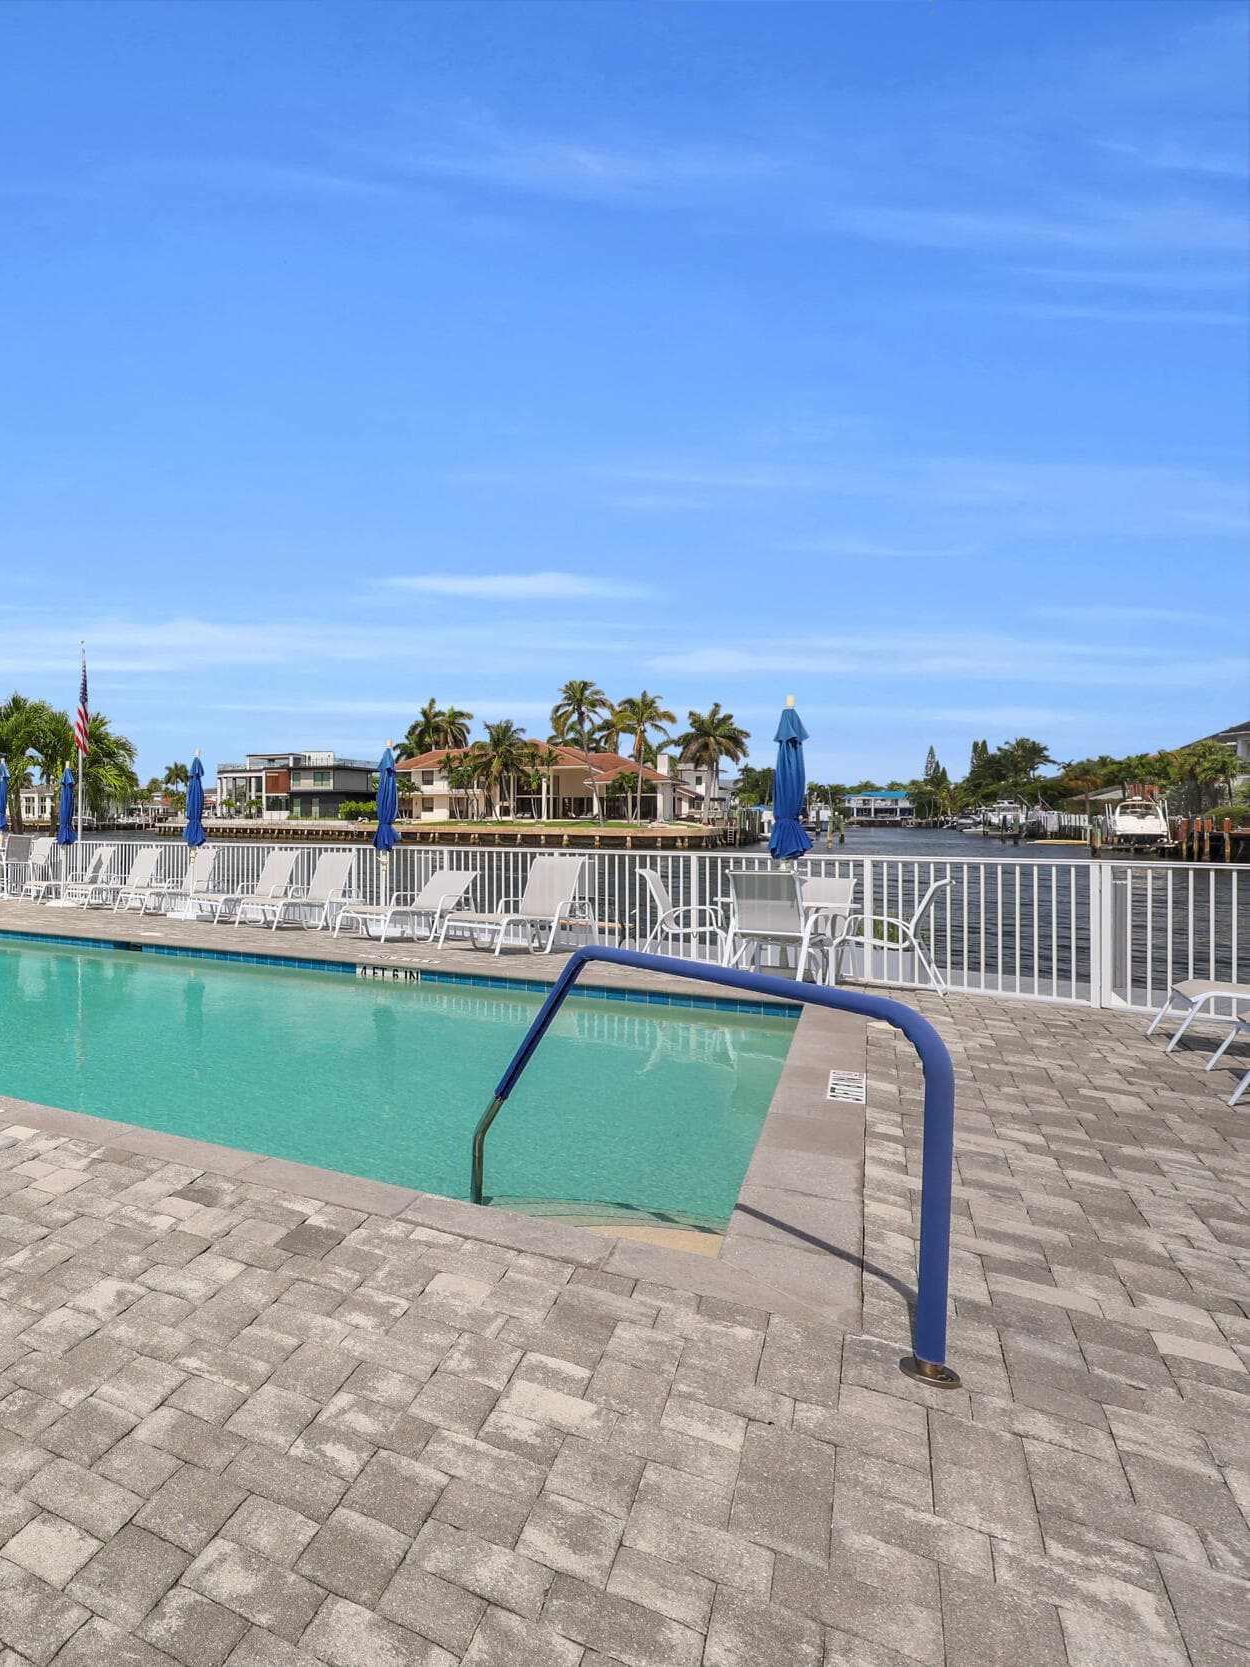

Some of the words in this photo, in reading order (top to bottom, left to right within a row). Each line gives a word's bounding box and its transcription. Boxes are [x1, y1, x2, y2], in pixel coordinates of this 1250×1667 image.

[361, 965, 367, 976] 4
[372, 966, 387, 977] FT
[392, 968, 399, 979] 6
[404, 970, 419, 980] IN
